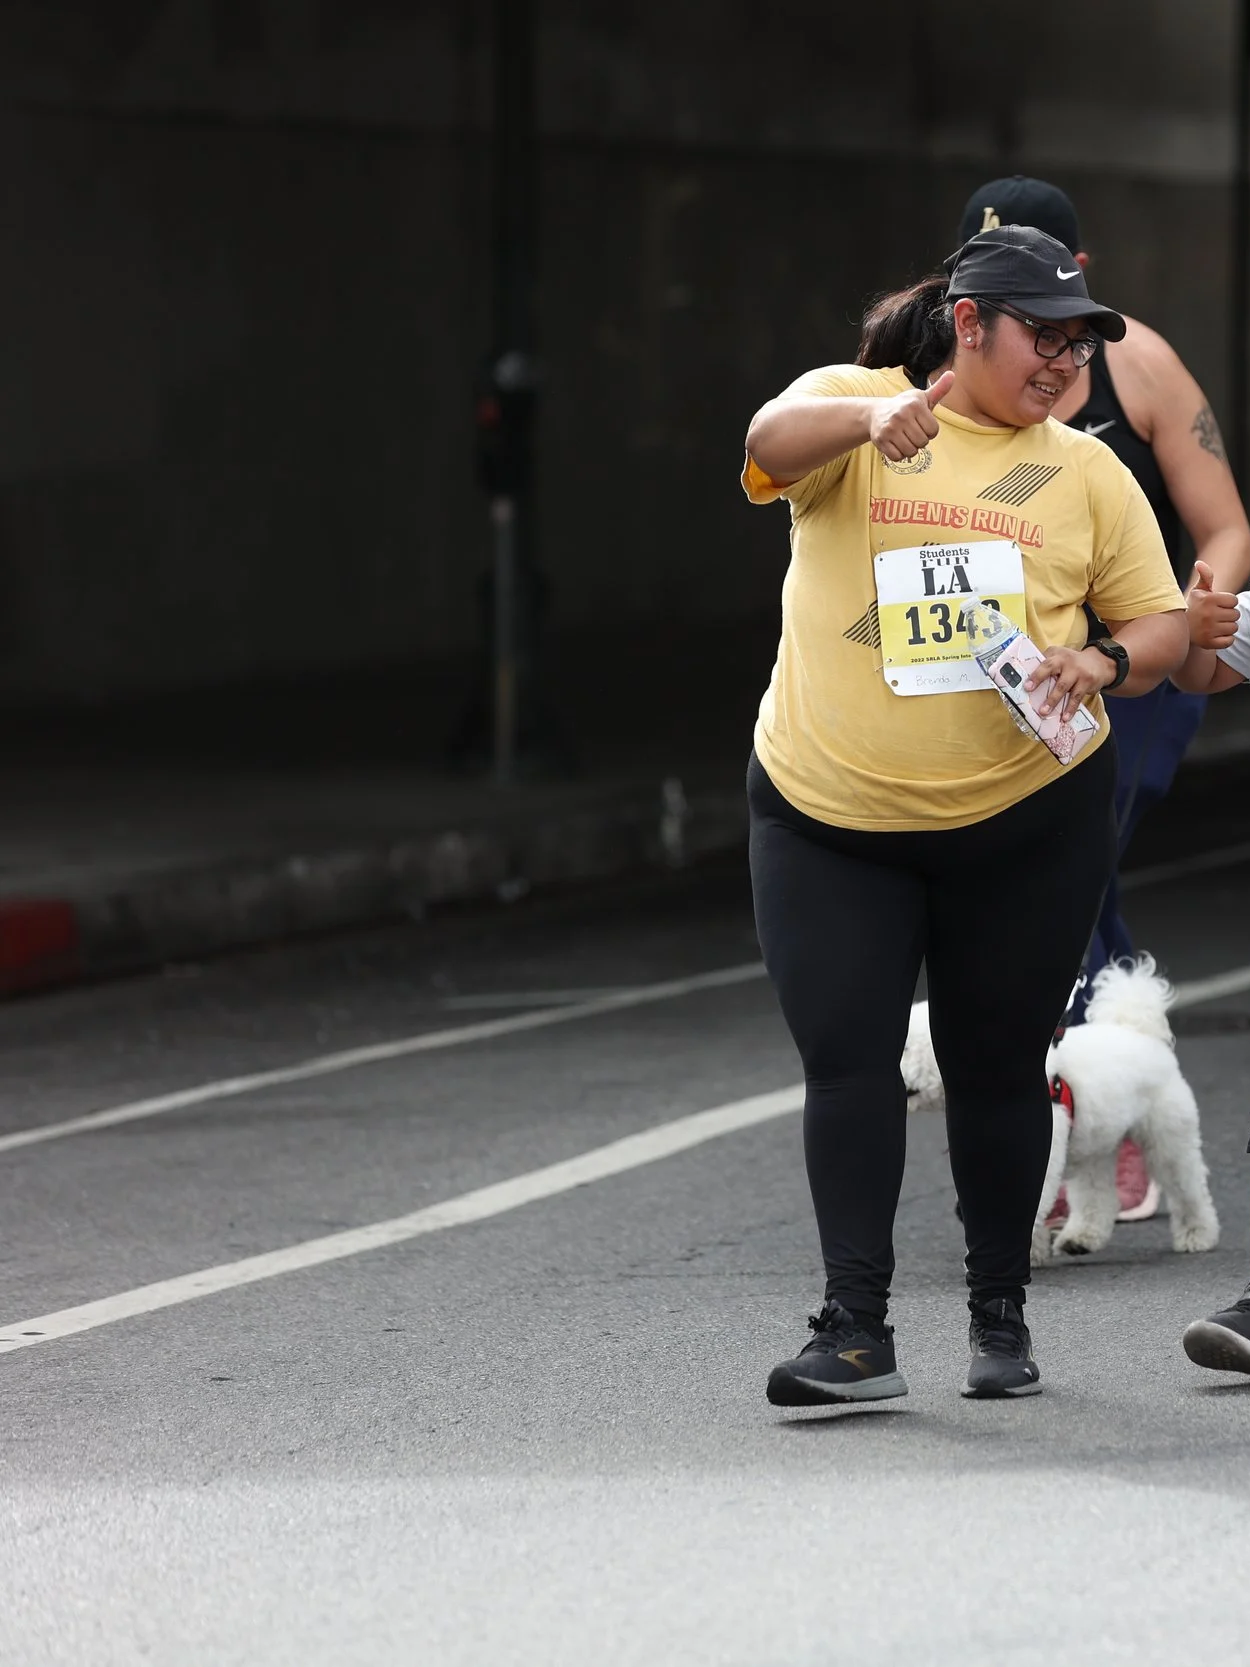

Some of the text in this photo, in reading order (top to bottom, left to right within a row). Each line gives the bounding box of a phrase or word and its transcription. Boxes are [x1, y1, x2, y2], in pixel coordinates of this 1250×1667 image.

[970, 508, 1018, 539] RUN
[1018, 520, 1044, 548] LA
[919, 547, 970, 559] Students
[921, 565, 973, 596] LA
